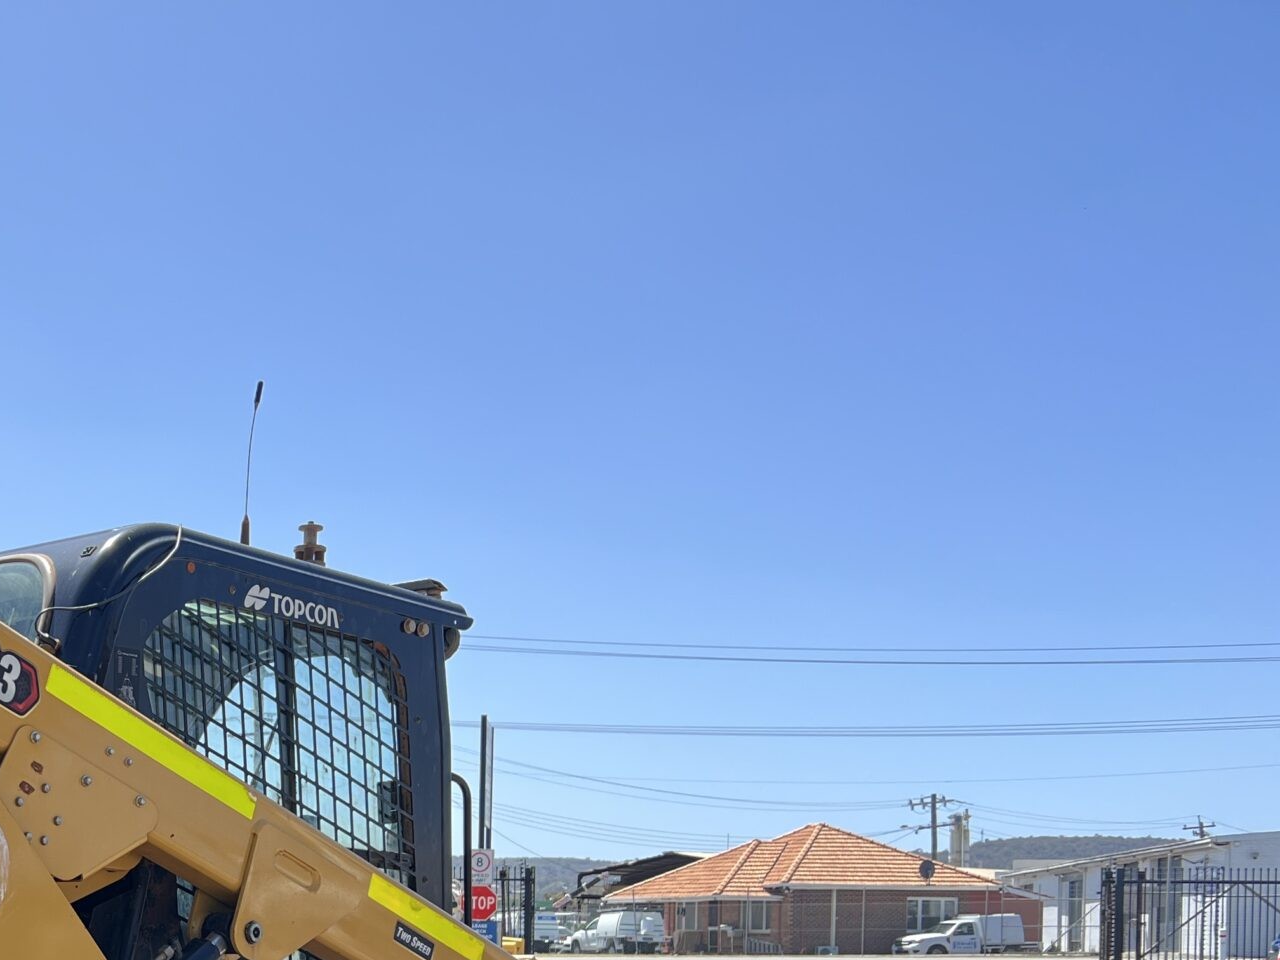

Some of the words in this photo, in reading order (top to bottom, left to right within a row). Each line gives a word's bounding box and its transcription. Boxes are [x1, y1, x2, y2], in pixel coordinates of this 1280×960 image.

[270, 593, 340, 629] TOPCON
[476, 857, 484, 867] 8
[472, 896, 495, 910] TOP
